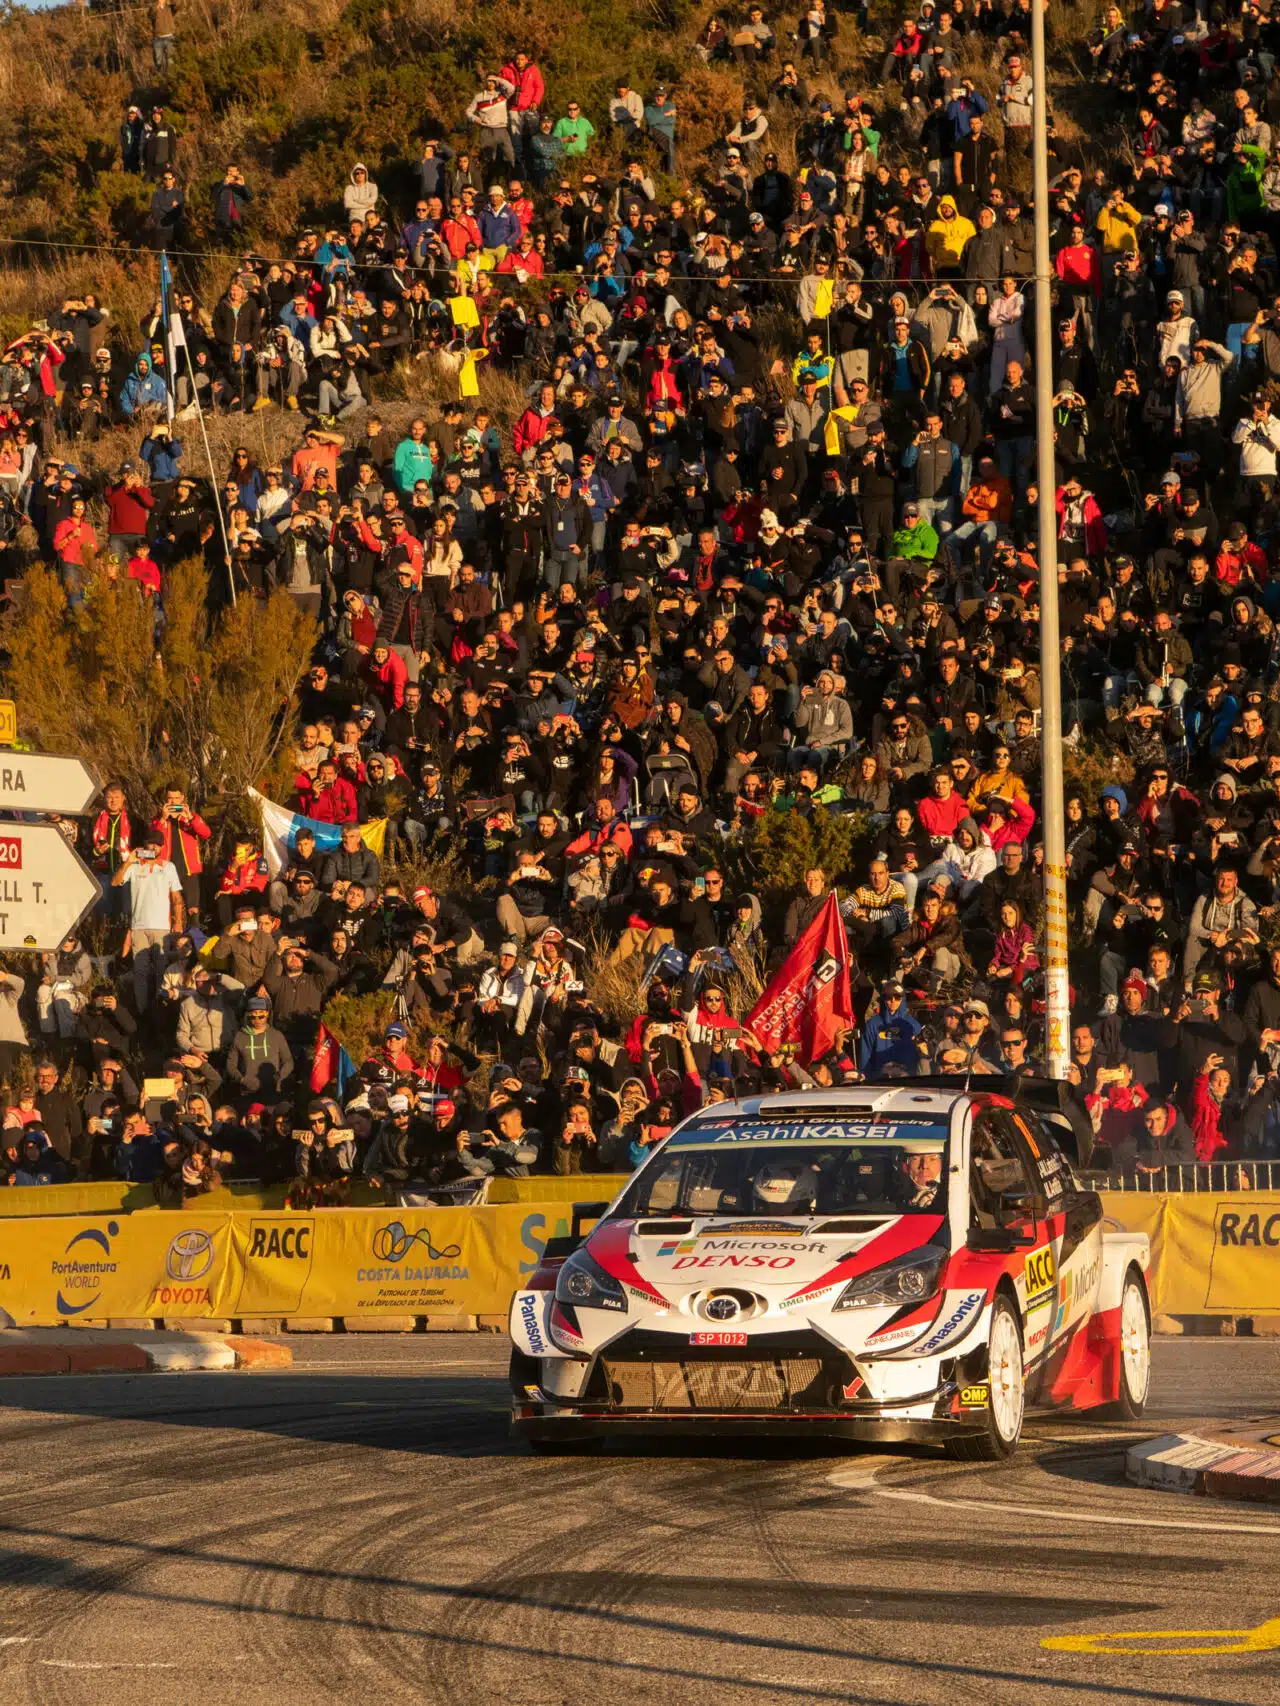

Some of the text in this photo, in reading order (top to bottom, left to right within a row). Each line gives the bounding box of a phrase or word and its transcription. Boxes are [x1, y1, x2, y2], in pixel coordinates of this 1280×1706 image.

[0, 879, 23, 902] LL
[736, 1119, 806, 1128] TOYOTA
[250, 1227, 310, 1259] RACC
[703, 1240, 828, 1254] Microsoft
[52, 1261, 117, 1274] PortAventura
[672, 1255, 796, 1270] DENSO
[357, 1265, 470, 1282] COSTA DAURADA
[1025, 1251, 1054, 1294] ACC
[65, 1276, 101, 1289] WORLD
[152, 1287, 211, 1305] TOYOTA
[603, 1299, 622, 1308] PIAA
[842, 1298, 867, 1308] PIAA
[518, 1294, 547, 1354] Panasonic
[913, 1293, 981, 1354] Panasonic
[698, 1333, 747, 1345] SP 1012
[961, 1388, 989, 1403] OMP
